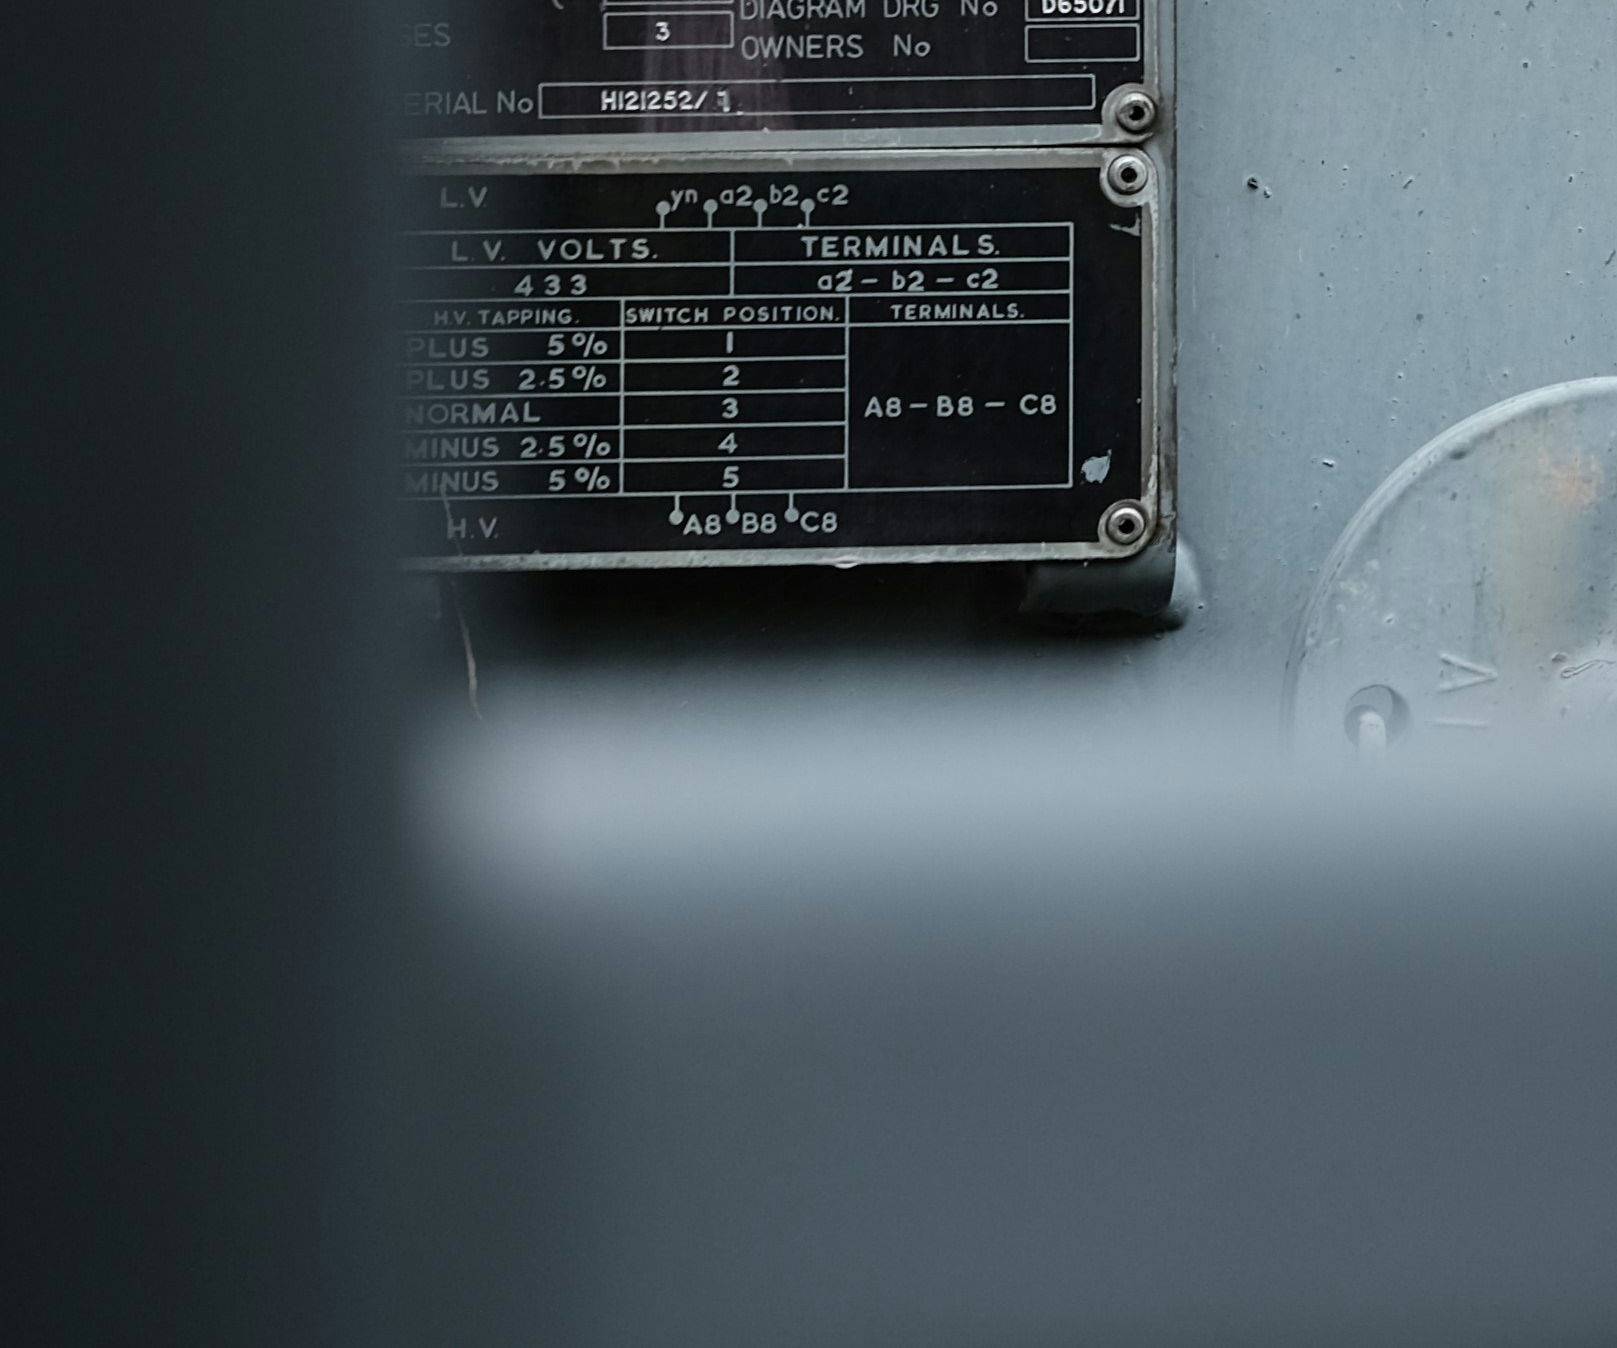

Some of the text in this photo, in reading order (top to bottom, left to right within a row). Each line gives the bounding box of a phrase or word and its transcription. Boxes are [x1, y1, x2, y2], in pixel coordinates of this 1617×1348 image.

[655, 20, 671, 44] 3
[741, 32, 931, 61] OWNERS No
[403, 91, 534, 117] ERIAL No
[671, 183, 850, 213] yn a2 b2 c2
[538, 236, 660, 261] VOLTS.
[801, 234, 1001, 258] TERMINALS.
[817, 268, 854, 293] a2
[891, 267, 926, 292] b2
[967, 268, 1000, 291] c2
[475, 307, 581, 327] TAPPING.
[625, 304, 841, 326] SWITCH POSITION.
[890, 302, 1025, 320] TERMINALS.
[406, 336, 489, 359] PLUS
[725, 331, 734, 354] 1
[406, 368, 490, 391] PLUS
[722, 365, 739, 388] 2
[405, 401, 541, 425] NORMAL
[721, 396, 739, 419] 3
[864, 396, 902, 418] A8
[935, 395, 975, 418] B8
[1020, 393, 1057, 416] C8
[405, 436, 500, 459] MINUS
[718, 433, 737, 455] 4
[405, 468, 500, 493] MINUS
[722, 465, 739, 489] 5
[682, 510, 838, 535] A8 B8 C8
